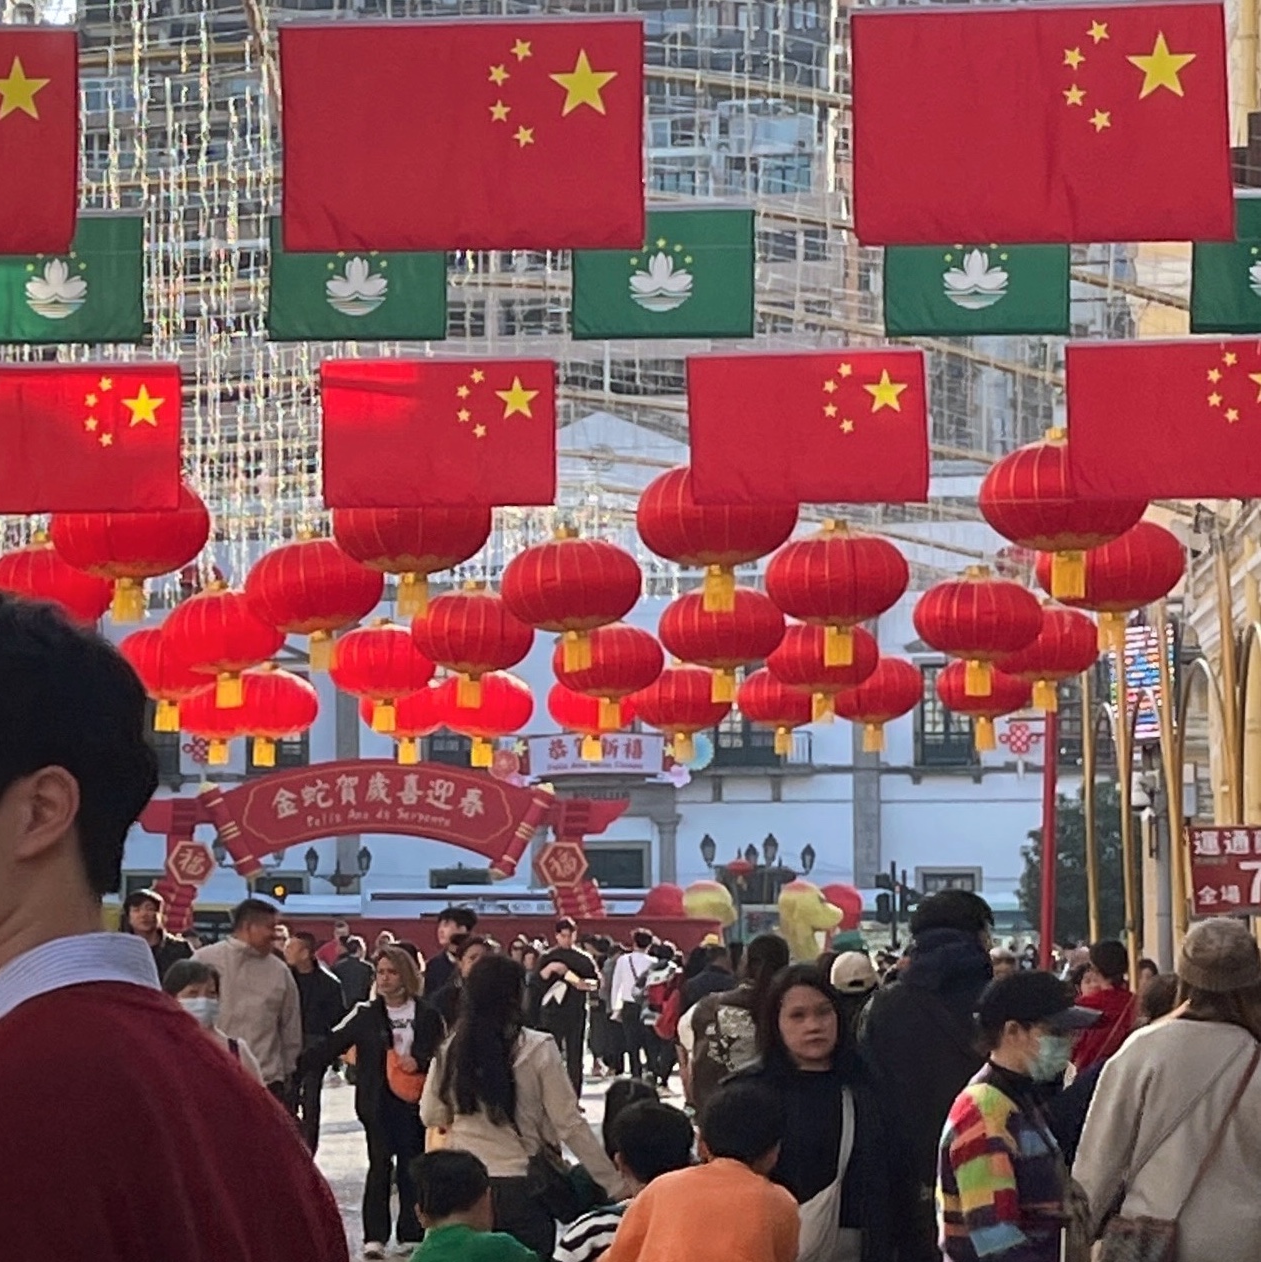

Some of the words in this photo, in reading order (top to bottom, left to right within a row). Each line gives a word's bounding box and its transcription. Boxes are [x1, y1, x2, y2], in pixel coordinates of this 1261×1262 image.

[272, 771, 485, 819] 金蛇賀歲喜迎春
[347, 807, 369, 821] Ano
[178, 848, 206, 875] 福
[548, 849, 577, 878] 福
